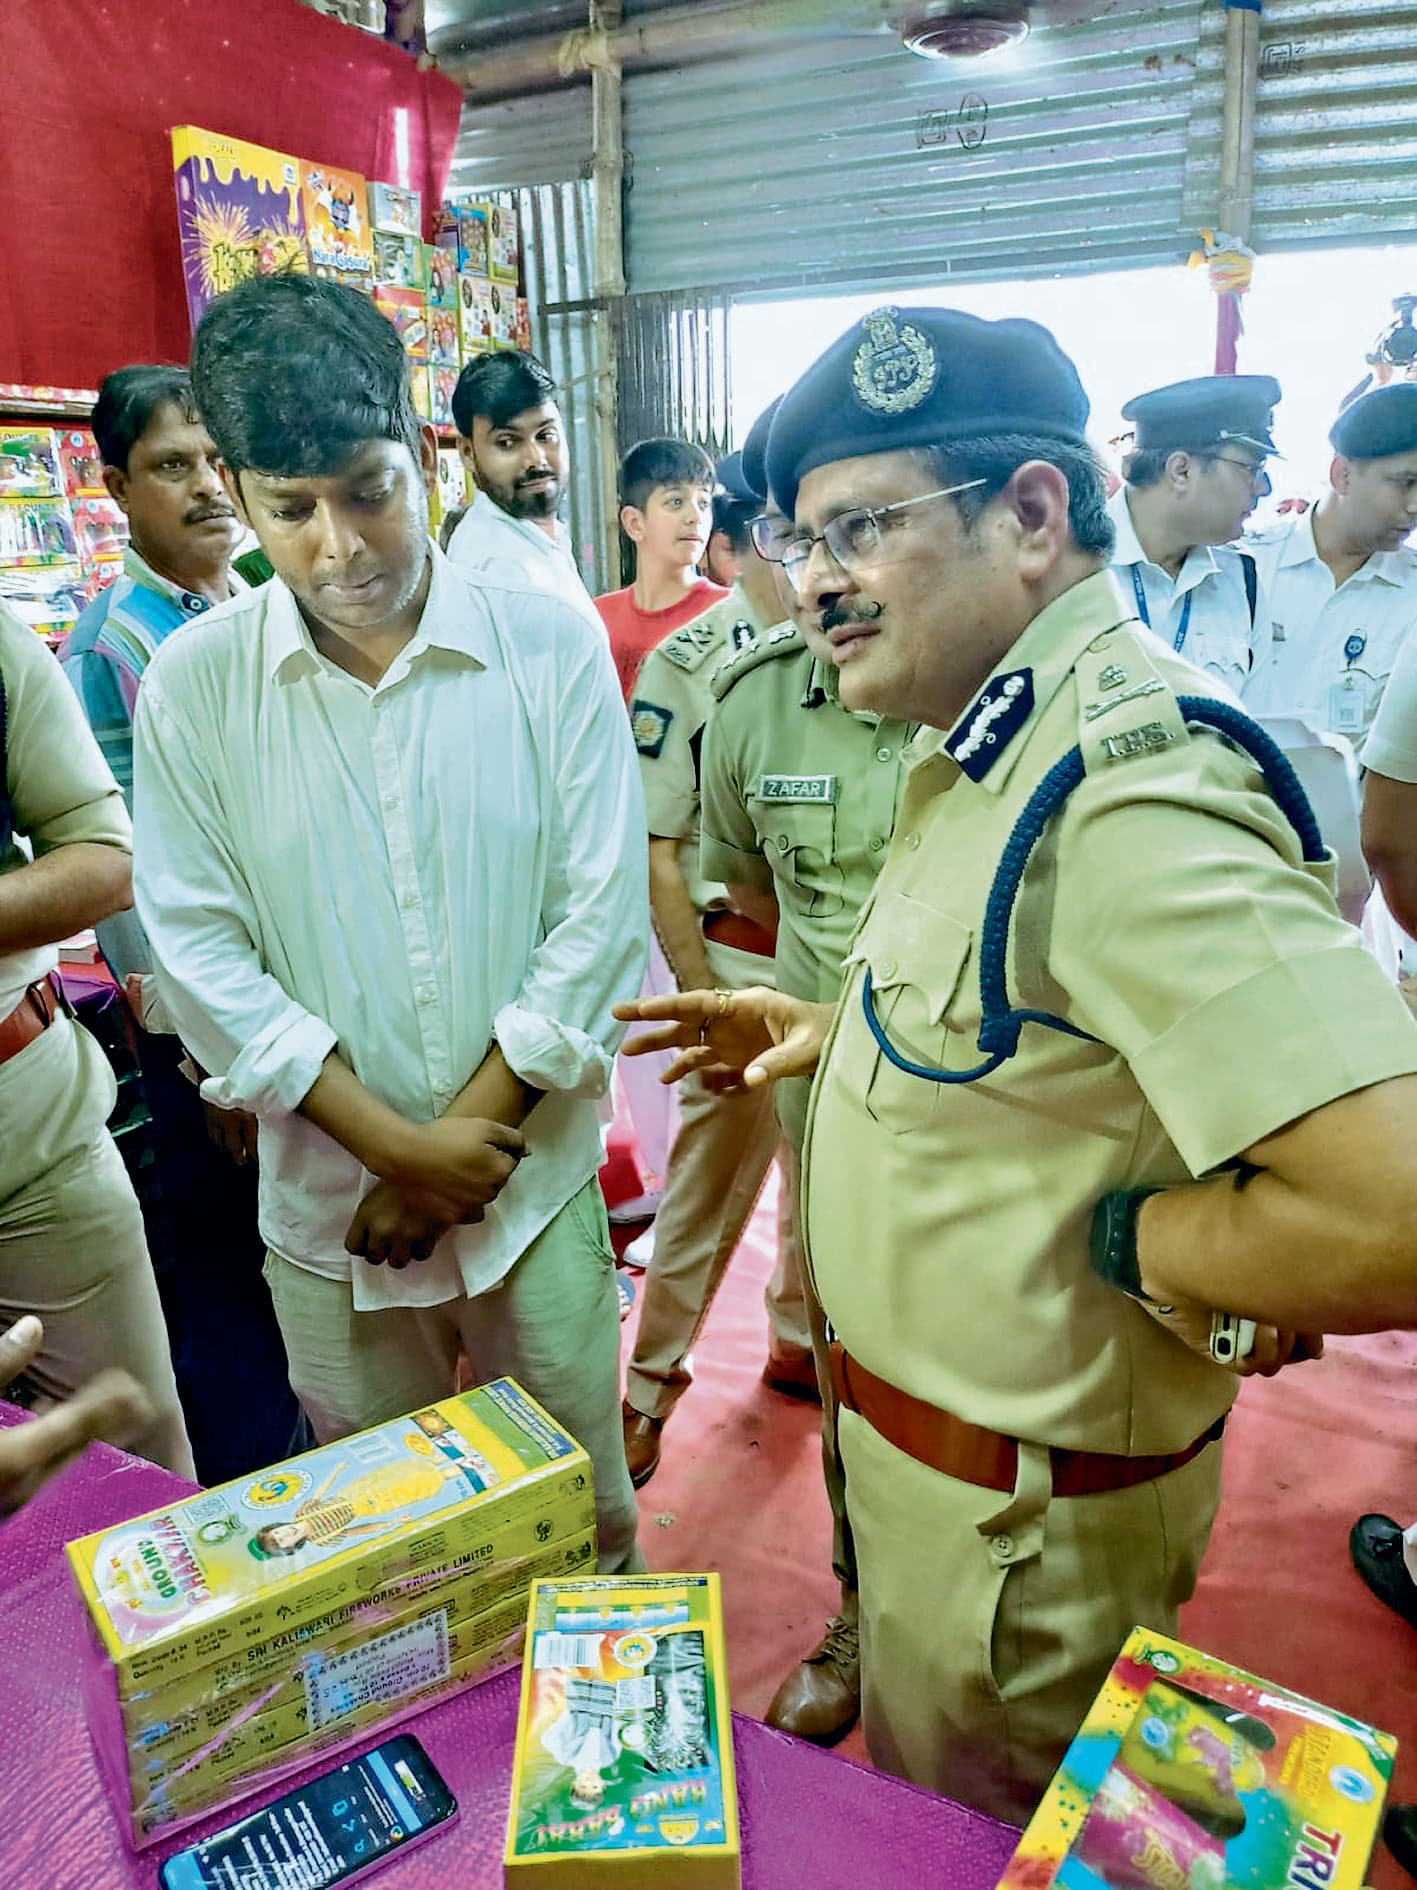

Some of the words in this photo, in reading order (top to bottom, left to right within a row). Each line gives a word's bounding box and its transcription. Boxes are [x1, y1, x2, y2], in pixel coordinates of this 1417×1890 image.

[767, 781, 820, 796] ZAFAR
[137, 1540, 177, 1599] GROUND
[247, 1644, 268, 1661] SRI
[339, 1586, 401, 1621] FIREWORKS
[406, 1563, 448, 1588] PRIVATE
[453, 1544, 494, 1568] LIMITED
